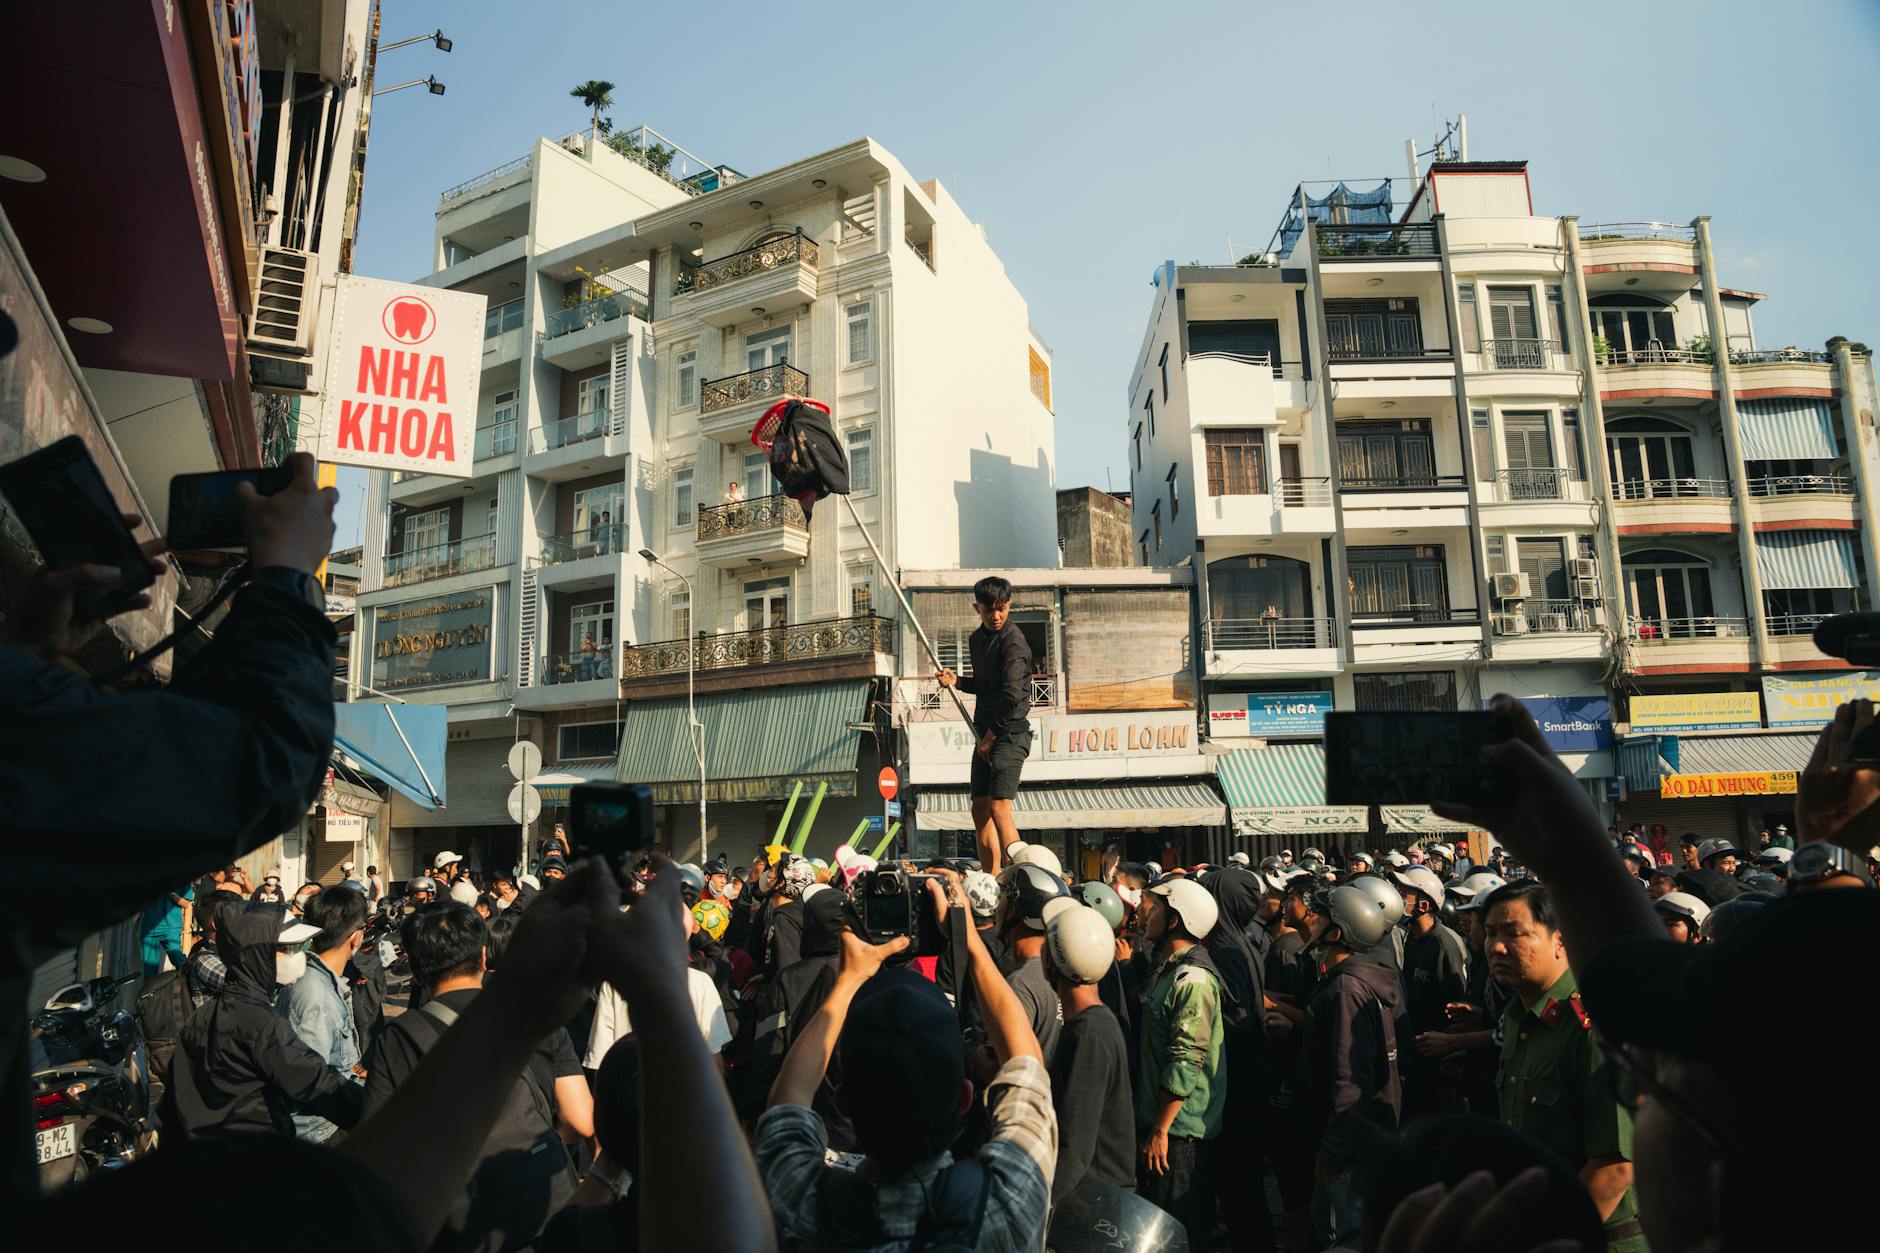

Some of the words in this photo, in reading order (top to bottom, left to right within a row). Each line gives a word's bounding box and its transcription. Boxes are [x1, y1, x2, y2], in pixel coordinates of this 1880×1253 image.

[356, 345, 447, 404] NHA
[337, 399, 455, 462] KHOA
[1286, 703, 1317, 715] NGA
[1544, 720, 1602, 732] SmartBank
[1069, 727, 1119, 752] HOA
[1127, 724, 1190, 750] LOAN
[1688, 776, 1713, 794] DÀI
[1717, 777, 1768, 793] NHUNG
[1770, 773, 1795, 781] 459
[1303, 816, 1360, 825] NGA
[37, 1127, 68, 1147] 9-M2
